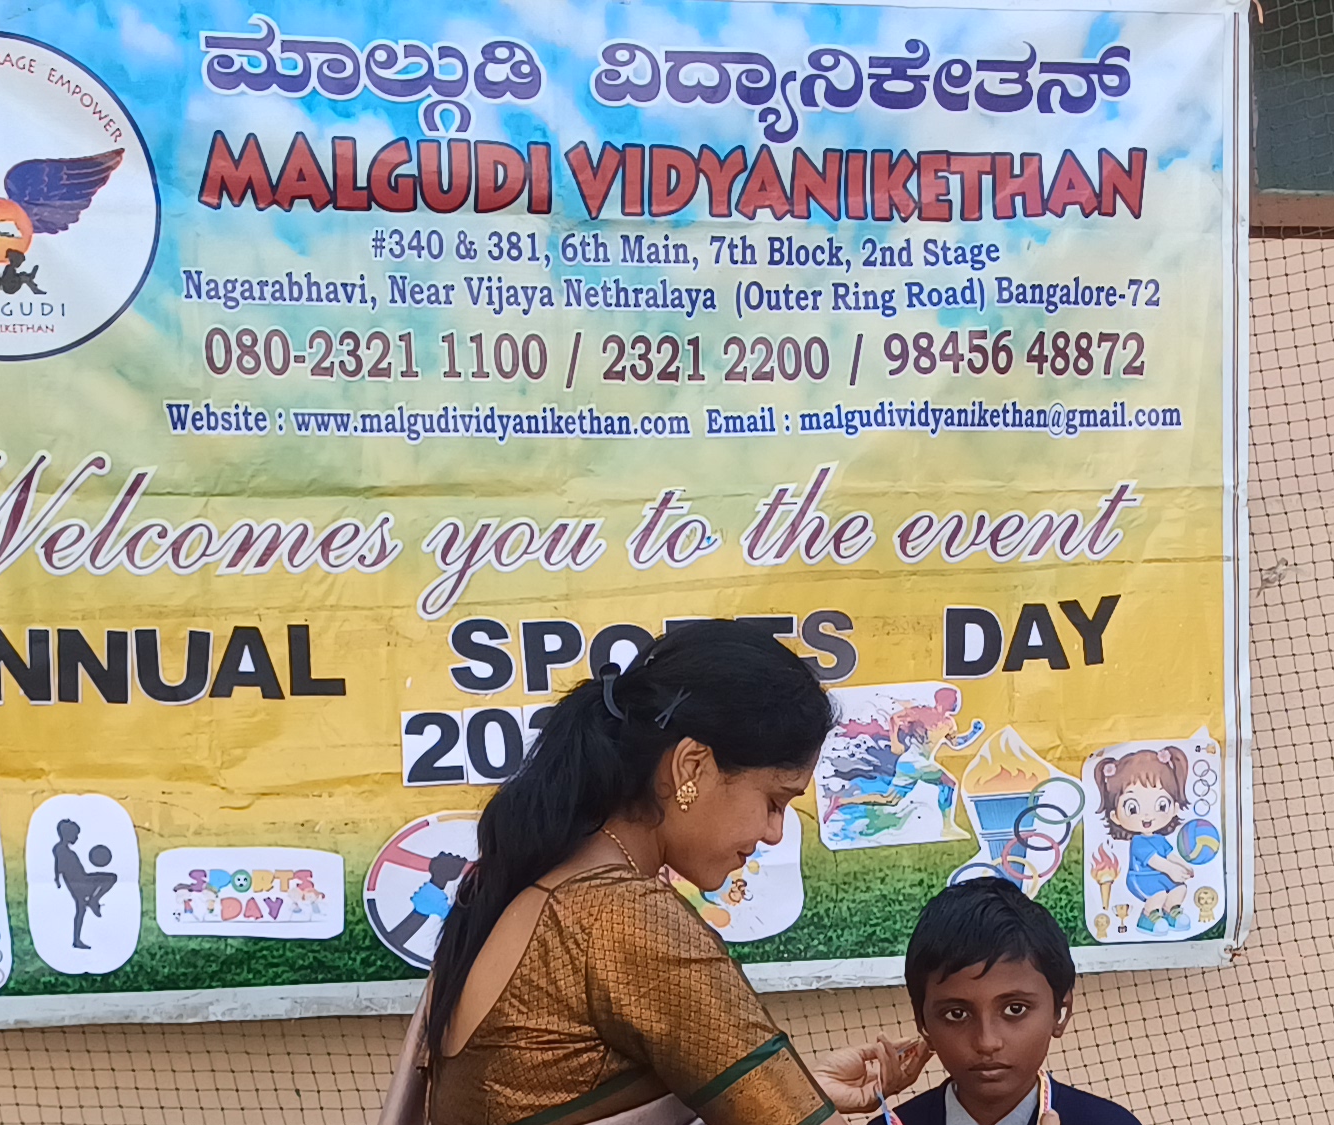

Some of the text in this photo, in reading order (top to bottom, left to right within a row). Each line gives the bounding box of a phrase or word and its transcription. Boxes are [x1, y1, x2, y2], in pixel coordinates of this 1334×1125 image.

[47, 67, 124, 143] EMPOWER
[595, 38, 1130, 143] ವಿದ್ಯಾನಿಕೇತನ್
[198, 130, 1148, 222] MALGUDI VIDYANIKETHAN
[371, 229, 1000, 273] #340 & 381, 6th Main, 7th Block, 2nd Stage
[183, 270, 1161, 318] Nagarabhavi, Near Vijaya Nethralaya (Outer Ring Road) Bangalore-72
[205, 327, 1145, 389] 080-2321 1100 / 2321 2200 / 98456 48872
[167, 404, 267, 432] Website
[292, 405, 690, 441] www.malgudividyanikethan.com
[707, 406, 776, 434] Email
[800, 401, 1183, 439] malgudividyanikethan@gmail.com
[422, 521, 602, 614] you
[632, 487, 718, 564] to
[744, 467, 875, 561] the
[898, 482, 1141, 560] event
[944, 594, 1122, 677] DAY
[220, 896, 284, 922] DAY
